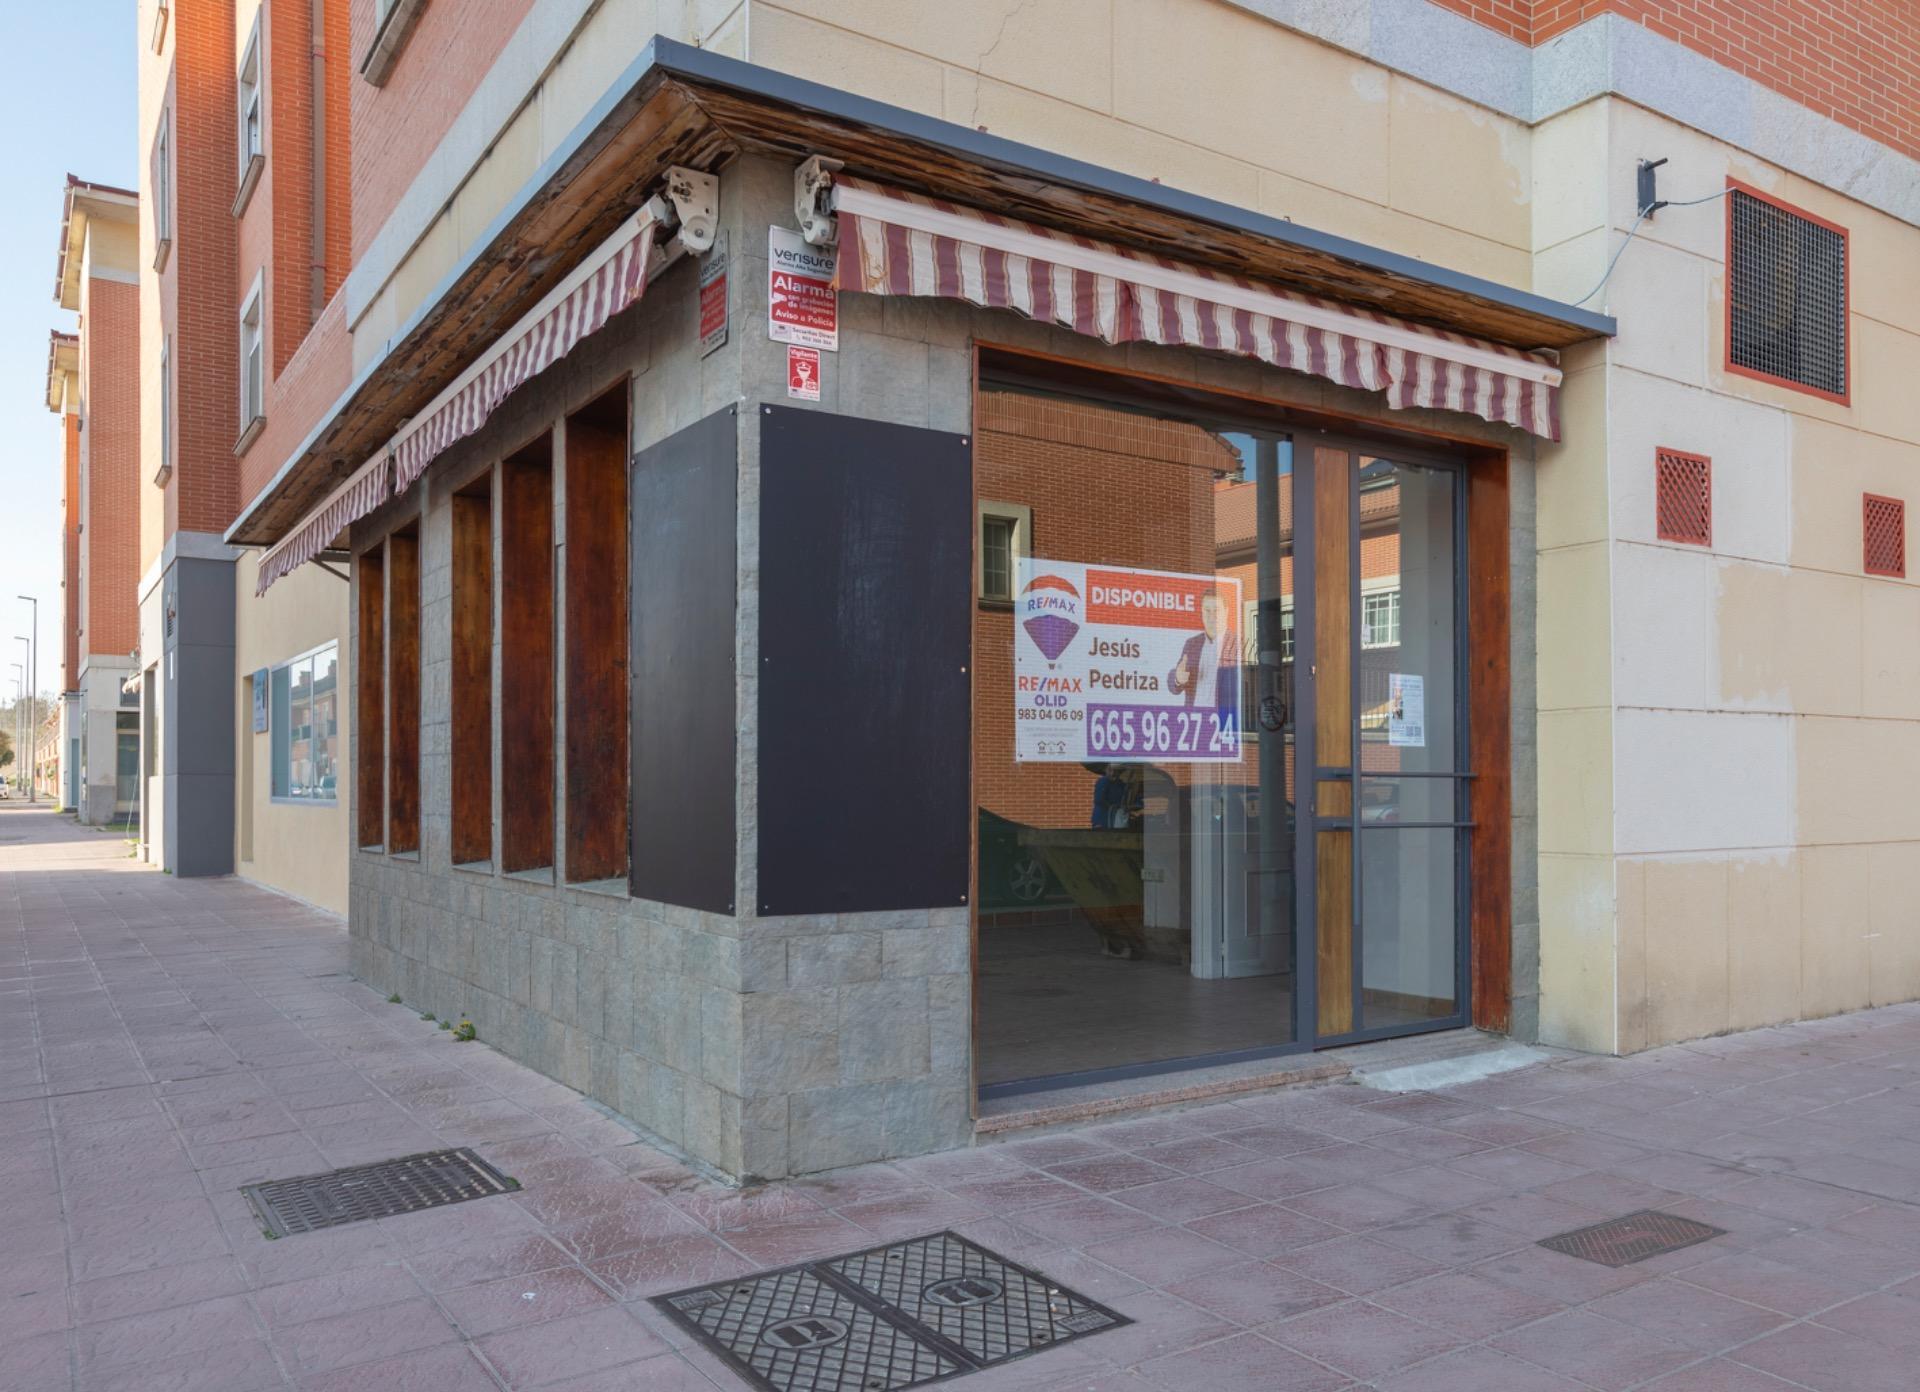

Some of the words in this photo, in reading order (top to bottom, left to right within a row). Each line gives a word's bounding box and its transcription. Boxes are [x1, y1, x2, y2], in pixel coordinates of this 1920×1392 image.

[774, 275, 834, 299] Alarma
[1028, 596, 1076, 614] RE/MAX
[1091, 586, 1195, 612] DISPONIBLE
[1088, 636, 1141, 658] Jesús
[1018, 676, 1082, 693] RE/MAX
[1088, 669, 1159, 691] Pedriza
[1034, 694, 1067, 707] OLID
[1018, 708, 1036, 720] 983
[1039, 709, 1053, 720] 04
[1055, 710, 1068, 720] 06
[1070, 710, 1083, 721] 09
[1091, 709, 1135, 751] 665
[1141, 710, 1171, 752] 96
[1177, 711, 1202, 752] 27
[1209, 712, 1235, 752] 24
